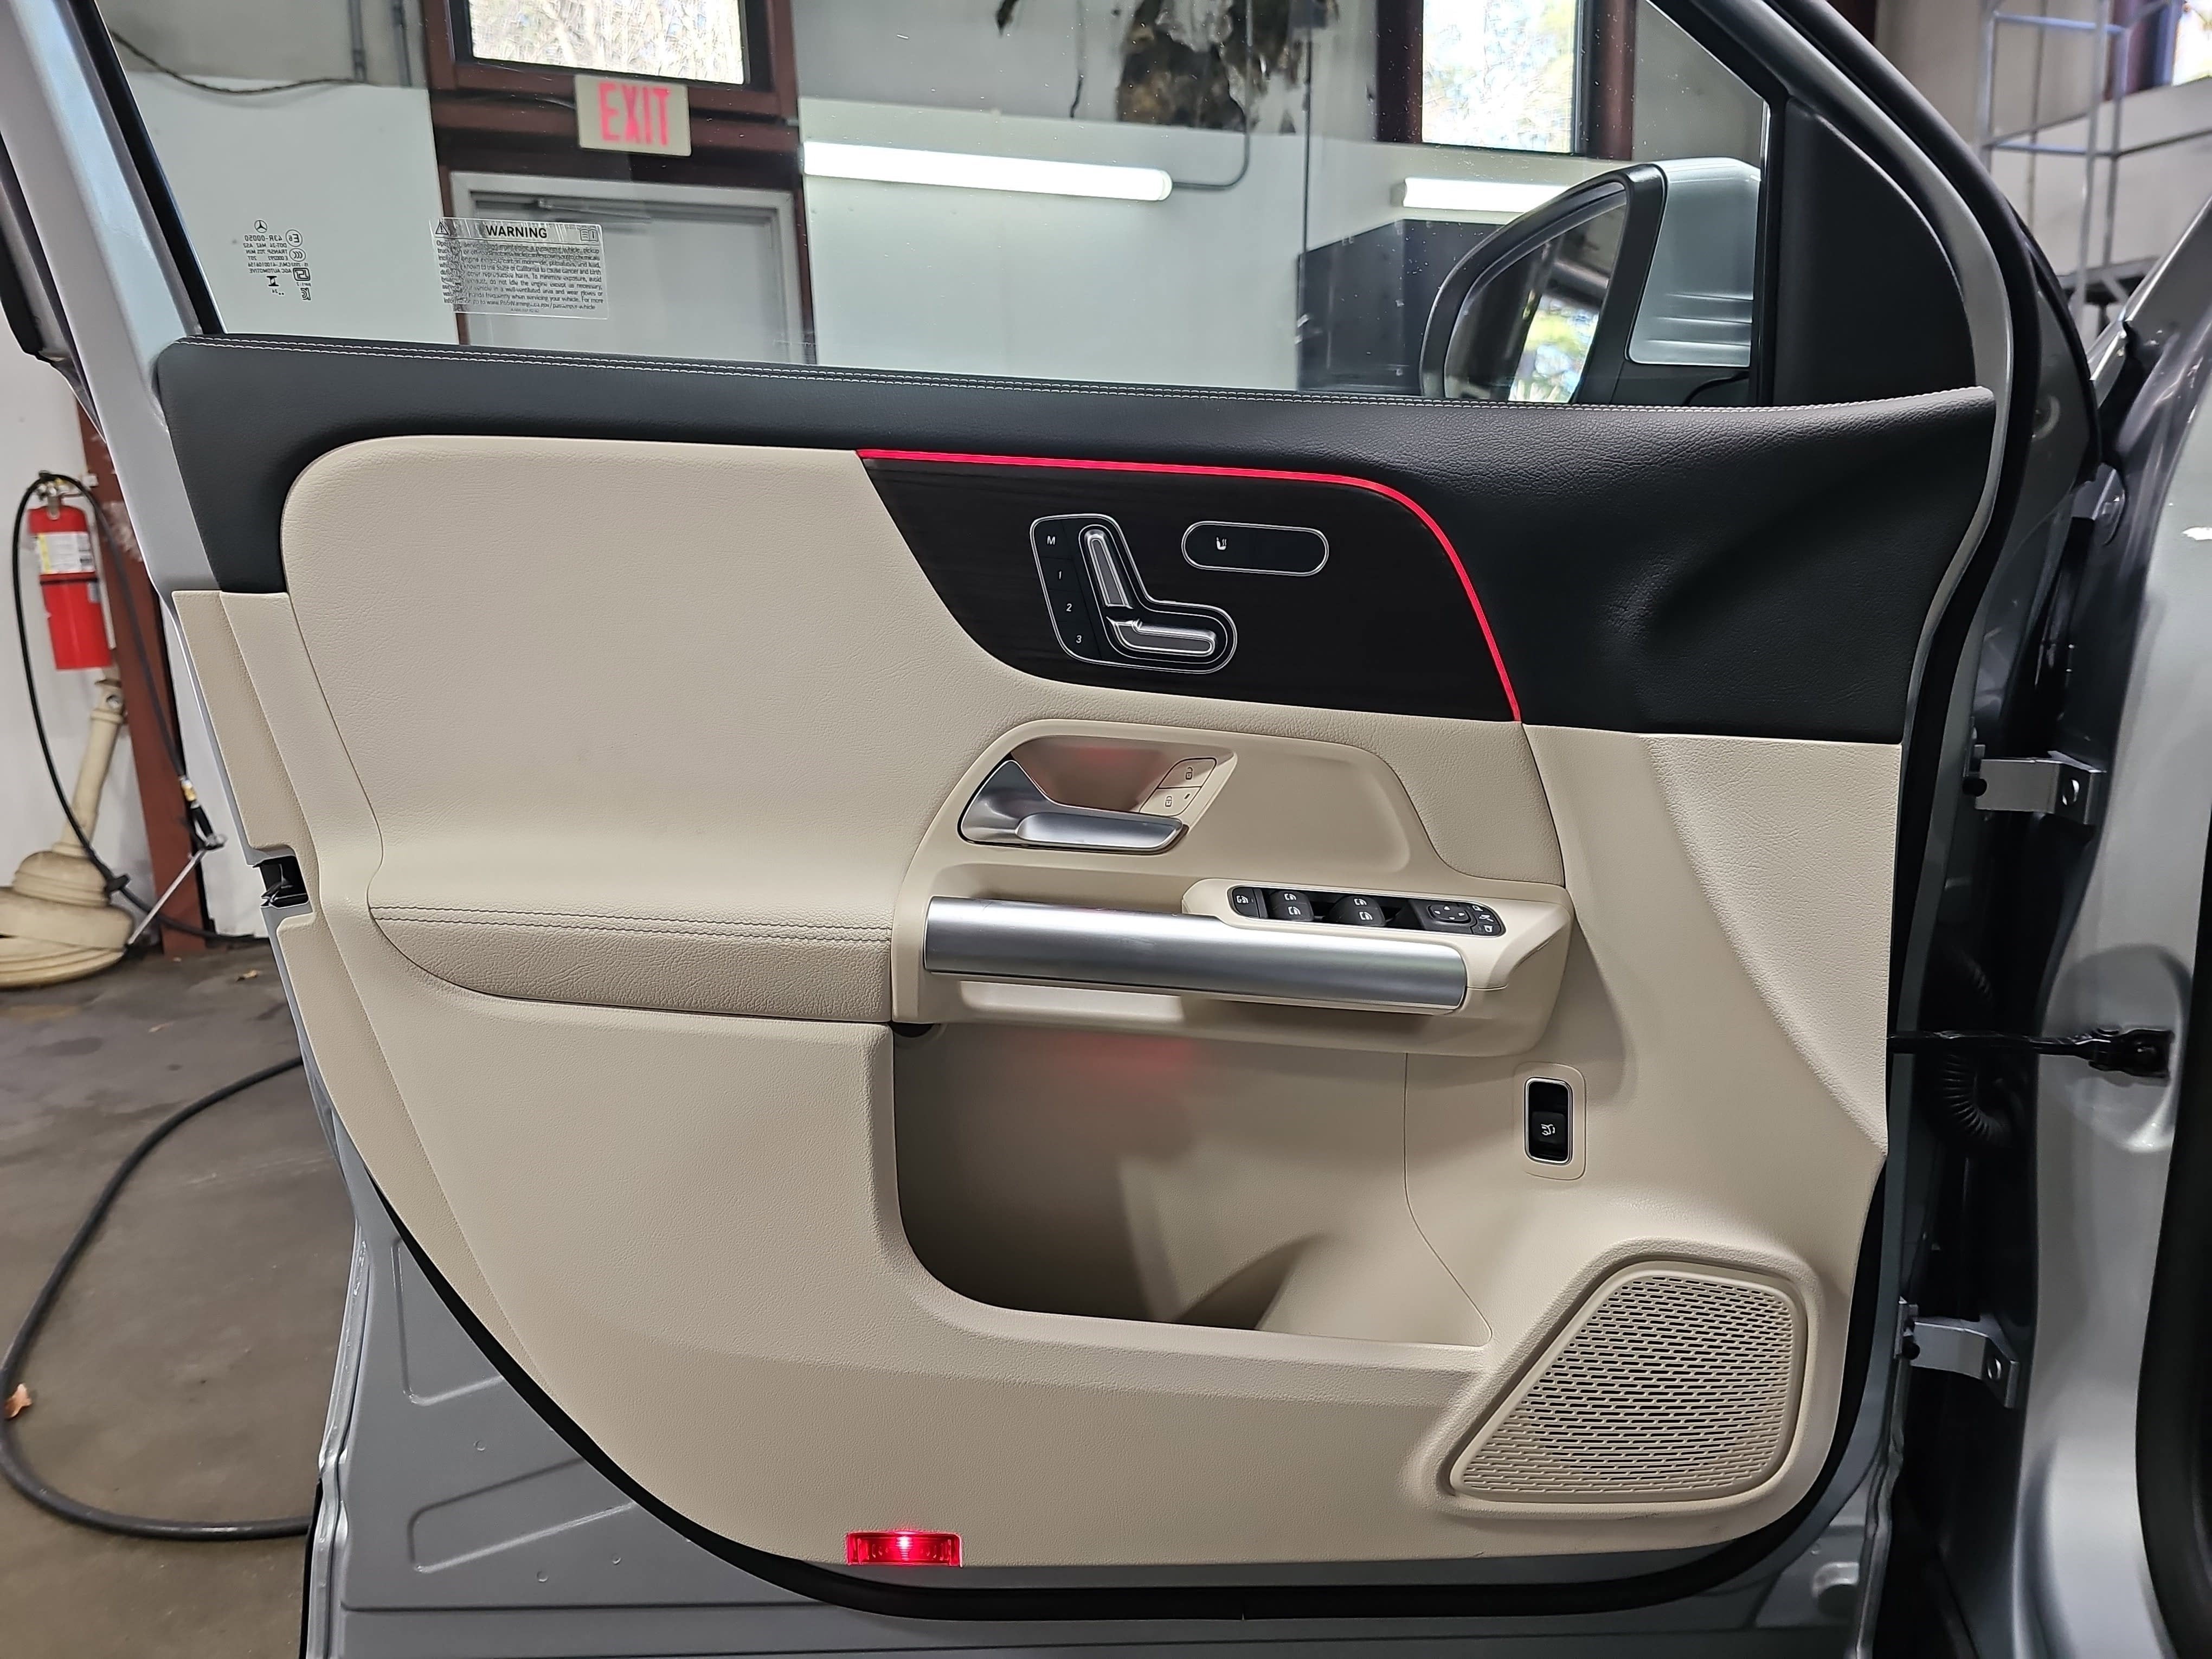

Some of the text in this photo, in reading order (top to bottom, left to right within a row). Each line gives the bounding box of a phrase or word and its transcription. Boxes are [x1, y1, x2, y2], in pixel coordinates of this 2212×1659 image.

[599, 82, 669, 145] EXIT
[486, 225, 547, 238] WARNING
[1047, 536, 1056, 545] M
[1058, 570, 1062, 580] 1
[1066, 603, 1072, 612] 2
[1076, 635, 1082, 644] 3
